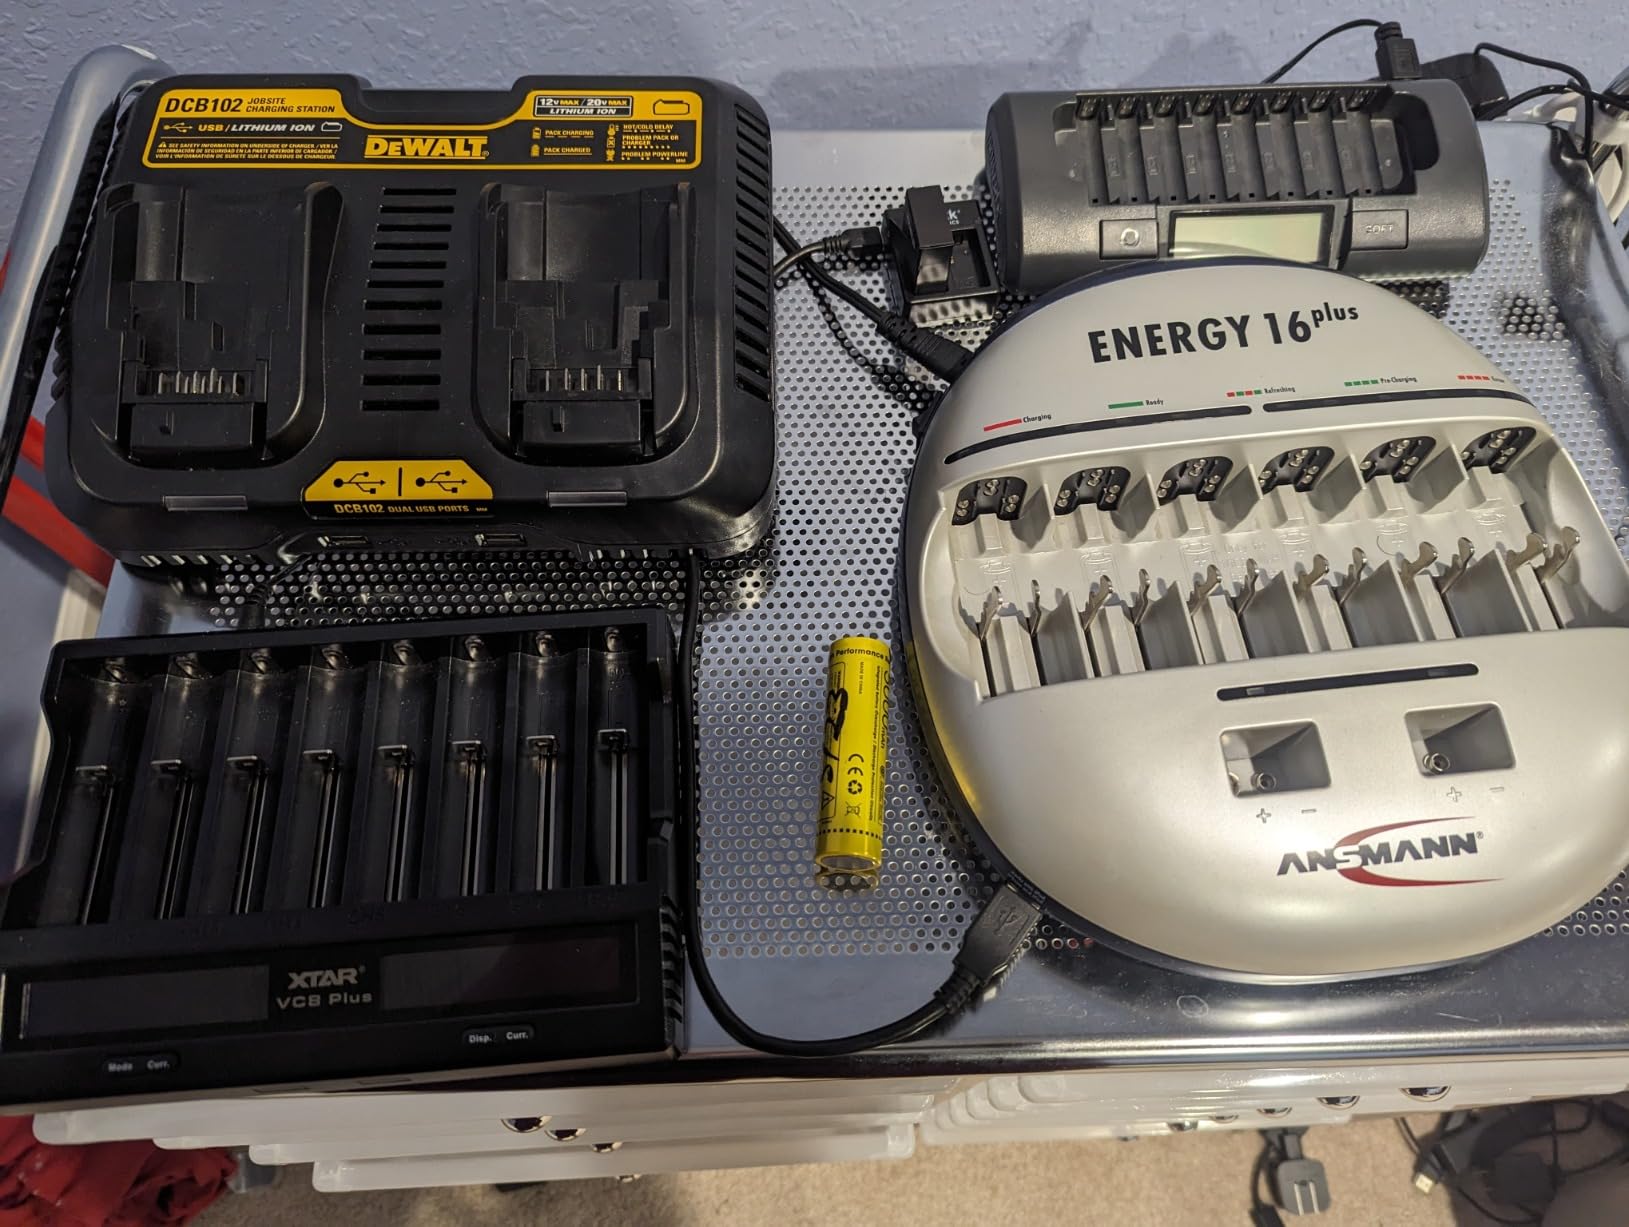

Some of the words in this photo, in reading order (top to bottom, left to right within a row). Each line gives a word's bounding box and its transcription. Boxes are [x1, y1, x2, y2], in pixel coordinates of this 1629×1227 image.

[165, 98, 243, 113] DCB102
[246, 105, 293, 113] CHARGING
[296, 105, 335, 113] STATION
[290, 124, 315, 132] ION
[1088, 314, 1250, 363] ENERGY
[1145, 398, 1164, 406] Ready
[1023, 412, 1052, 424] Charging
[334, 504, 385, 514] DCB102
[387, 505, 414, 513] DUAL
[836, 648, 884, 660] Performance
[1277, 832, 1479, 876] ANSMANN
[288, 967, 358, 990] XTAR
[328, 992, 372, 1006] Plus
